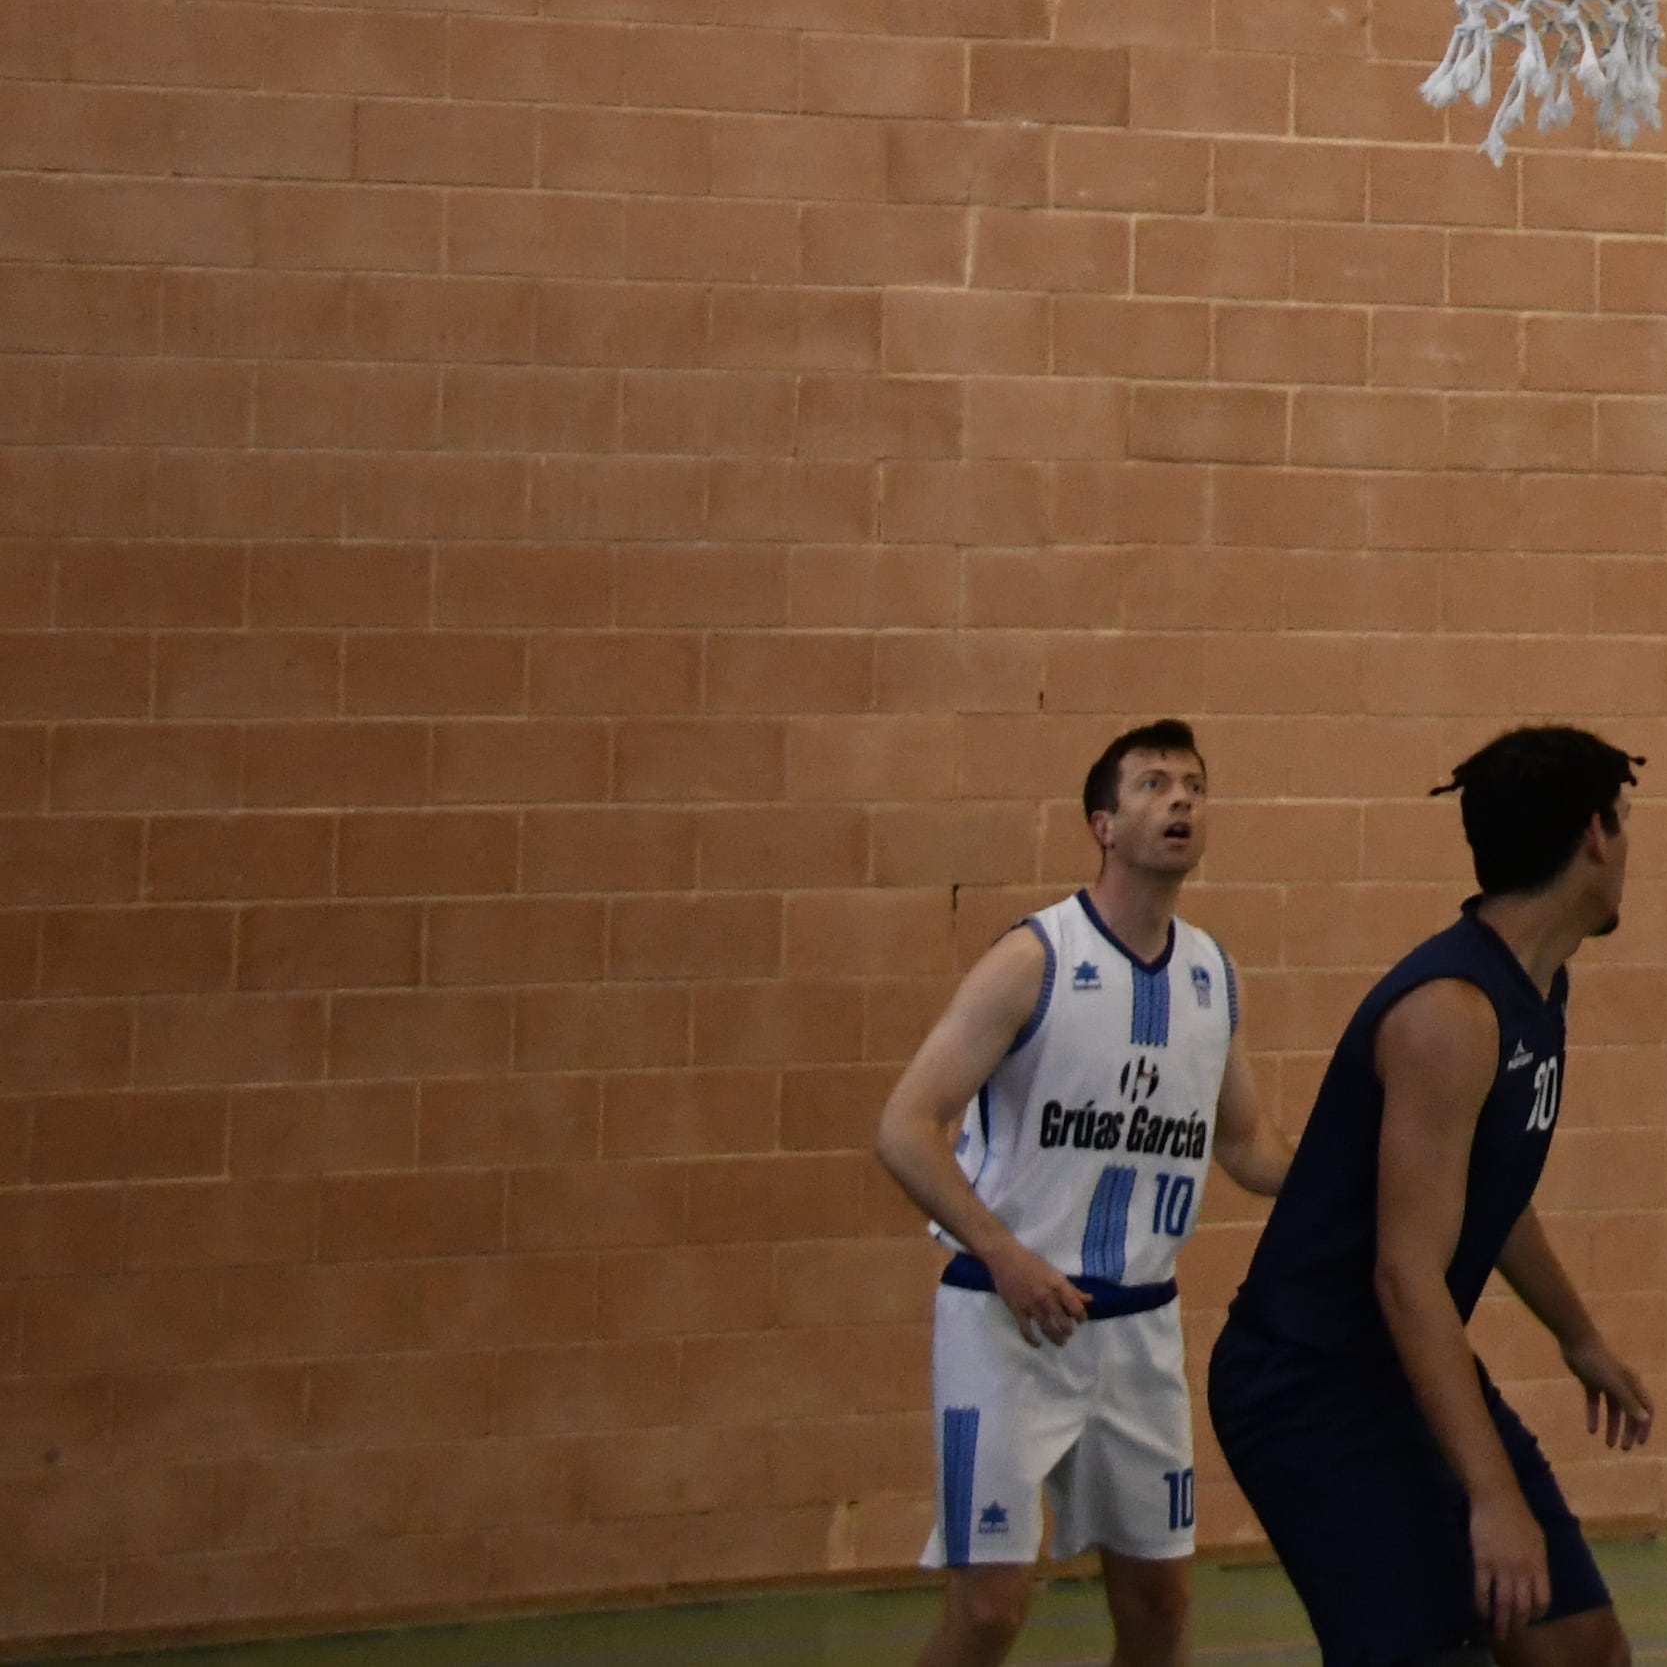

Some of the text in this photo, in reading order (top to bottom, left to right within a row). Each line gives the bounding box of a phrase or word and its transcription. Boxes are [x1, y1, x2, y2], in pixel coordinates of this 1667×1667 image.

[1040, 1099, 1208, 1160] Grúas García
[1152, 1172, 1195, 1237] 10
